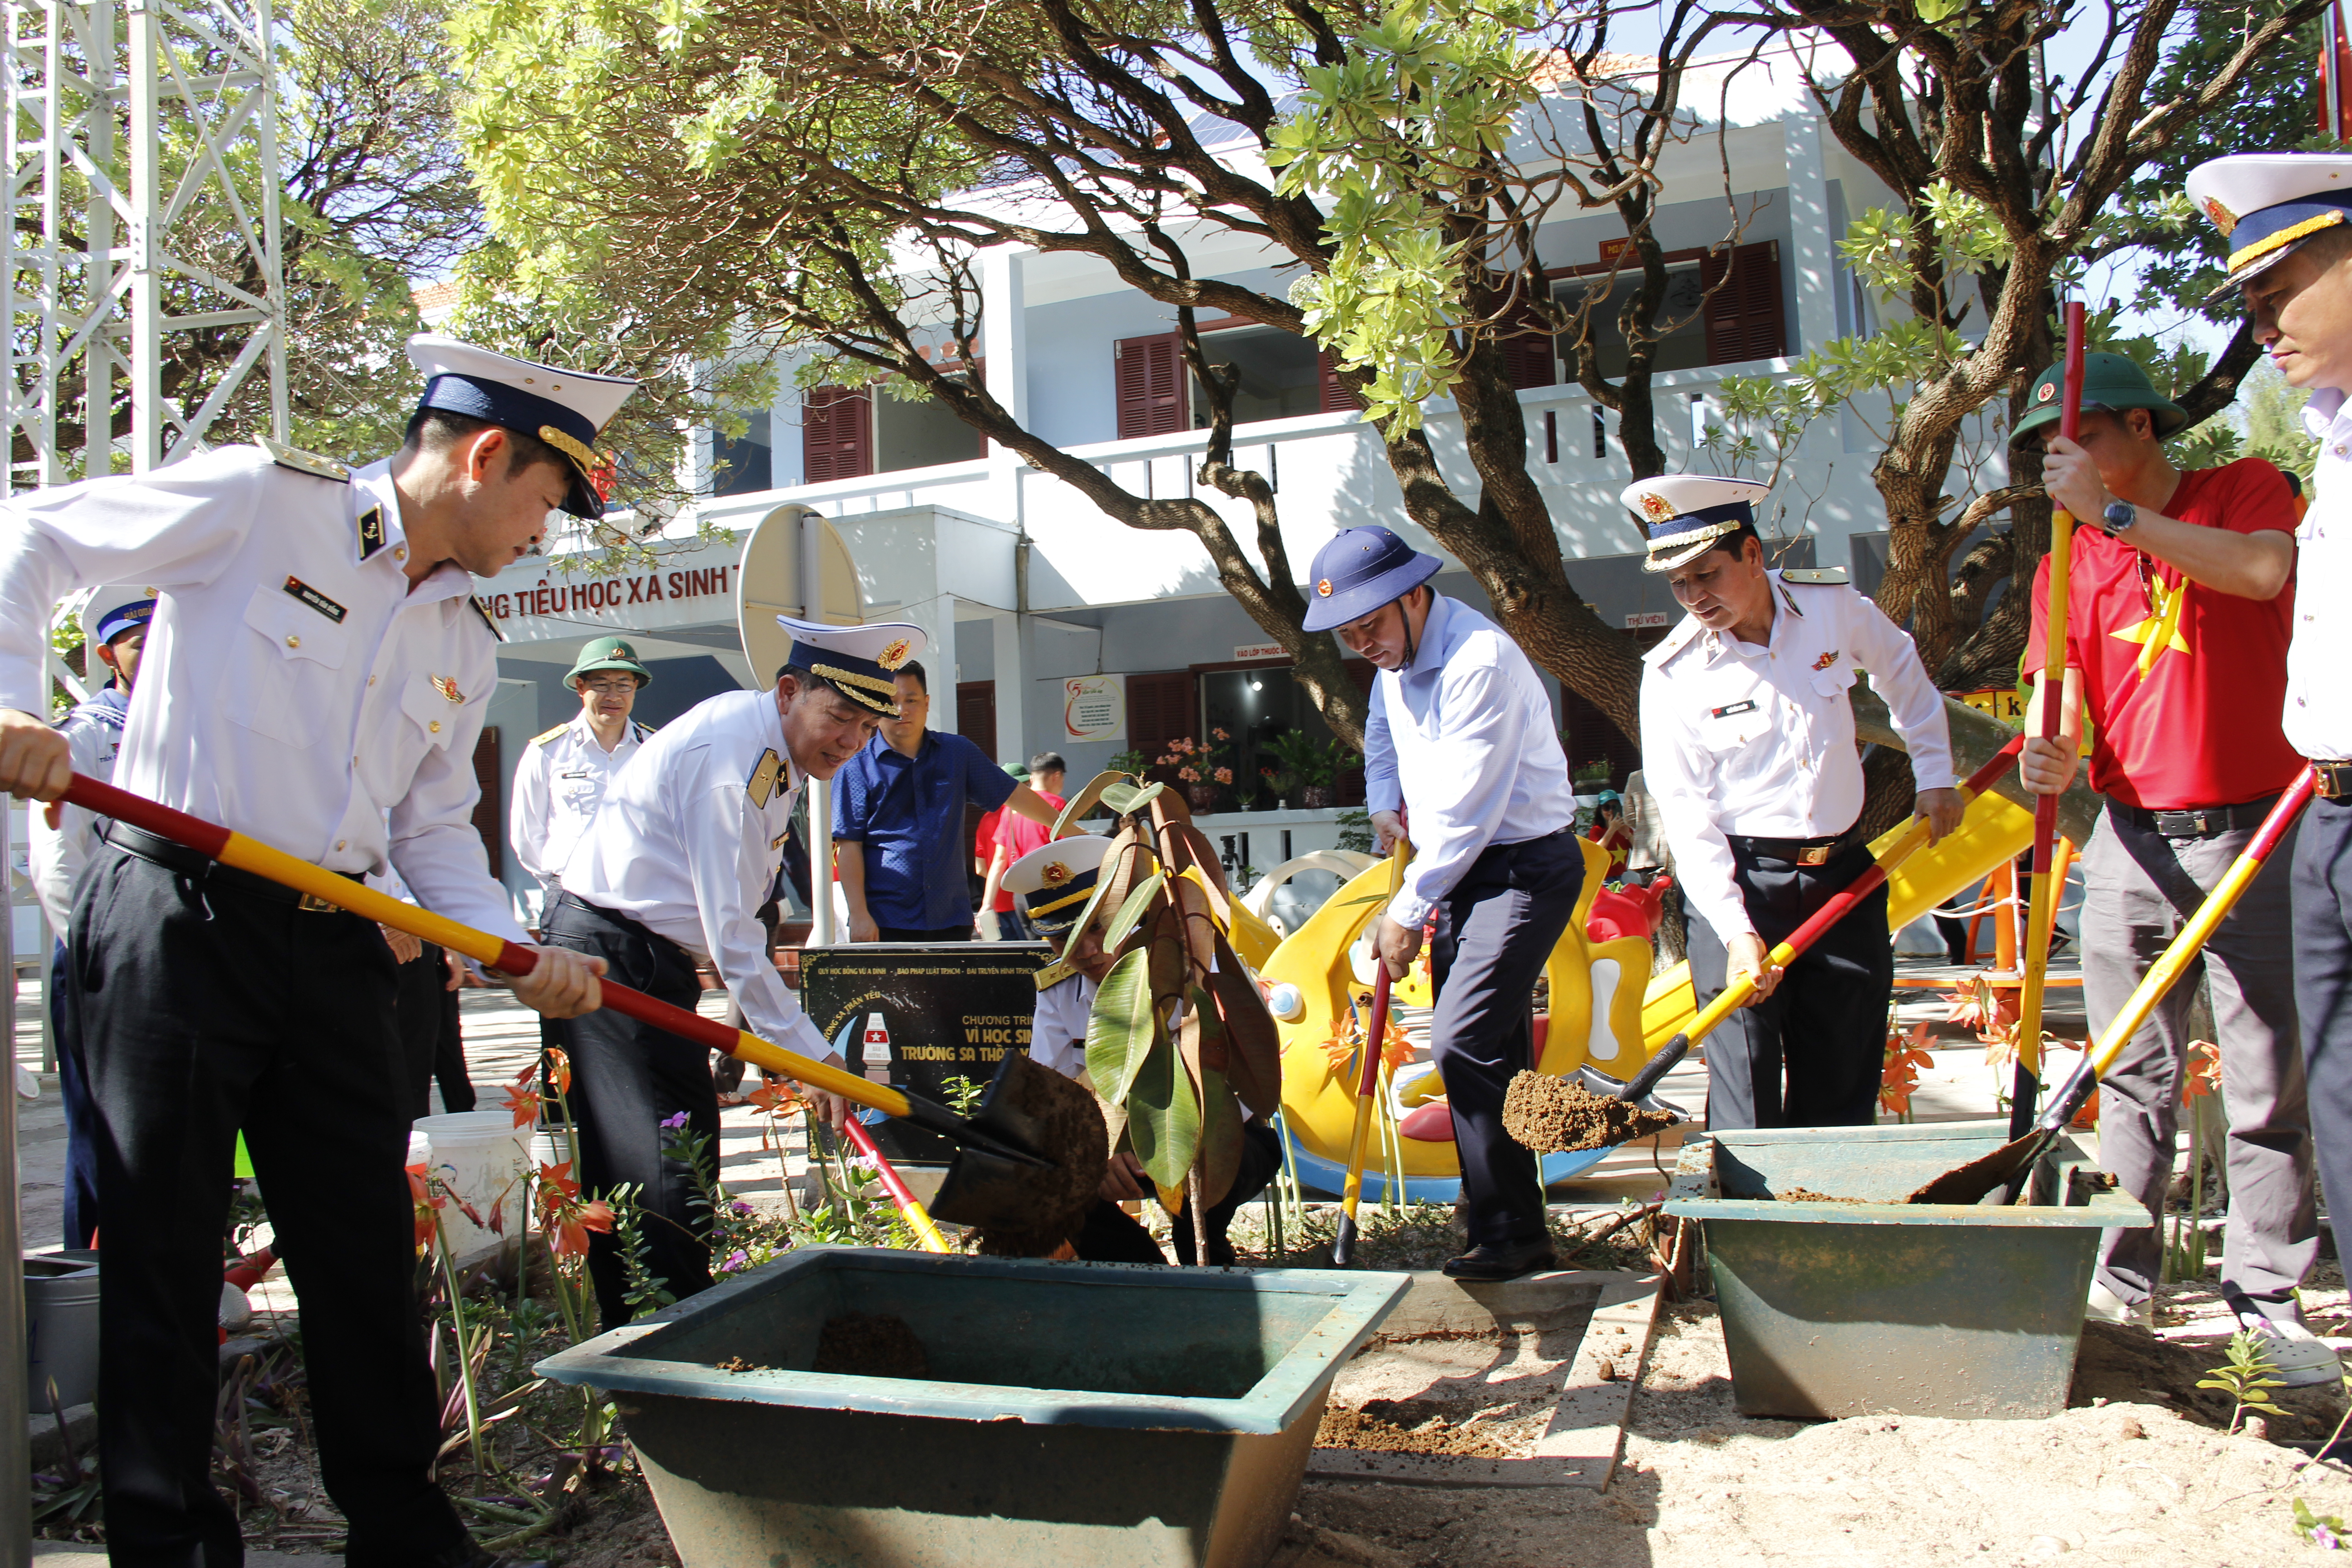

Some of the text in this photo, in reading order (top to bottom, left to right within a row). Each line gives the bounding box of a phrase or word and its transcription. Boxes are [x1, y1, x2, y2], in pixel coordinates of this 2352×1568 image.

[514, 569, 567, 617] TIỂU
[572, 579, 621, 615] HỌC
[668, 566, 728, 599] SINH
[1645, 614, 1664, 625] VIỆN
[835, 1010, 847, 1021] SA
[843, 995, 864, 1012] THÂN
[863, 990, 881, 1000] YÊU
[962, 1015, 1010, 1025] CHƯƠNG
[965, 1026, 979, 1043] VÌ
[900, 1044, 956, 1061] TRƯỜNG
[959, 1047, 975, 1061] SA
